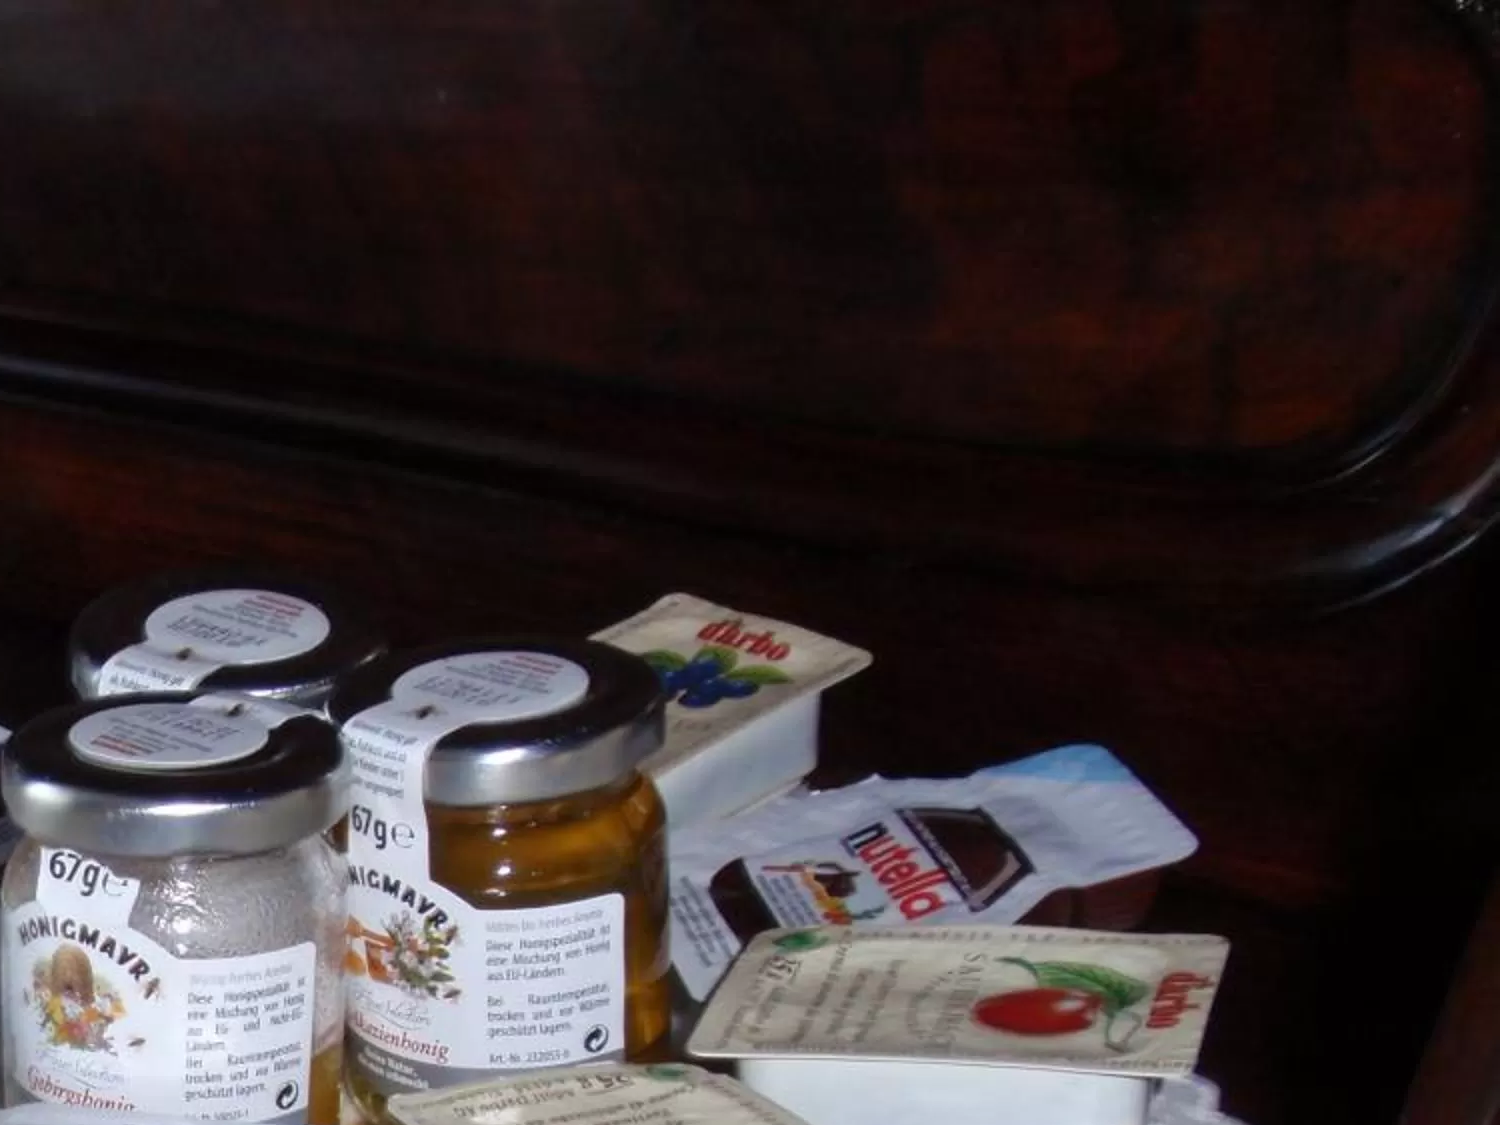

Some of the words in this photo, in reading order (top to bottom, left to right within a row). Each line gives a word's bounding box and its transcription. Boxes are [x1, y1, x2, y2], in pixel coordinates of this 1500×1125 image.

[348, 864, 450, 930] NIGMAYR
[846, 822, 948, 920] nutella
[18, 915, 150, 981] HONIGMAYR
